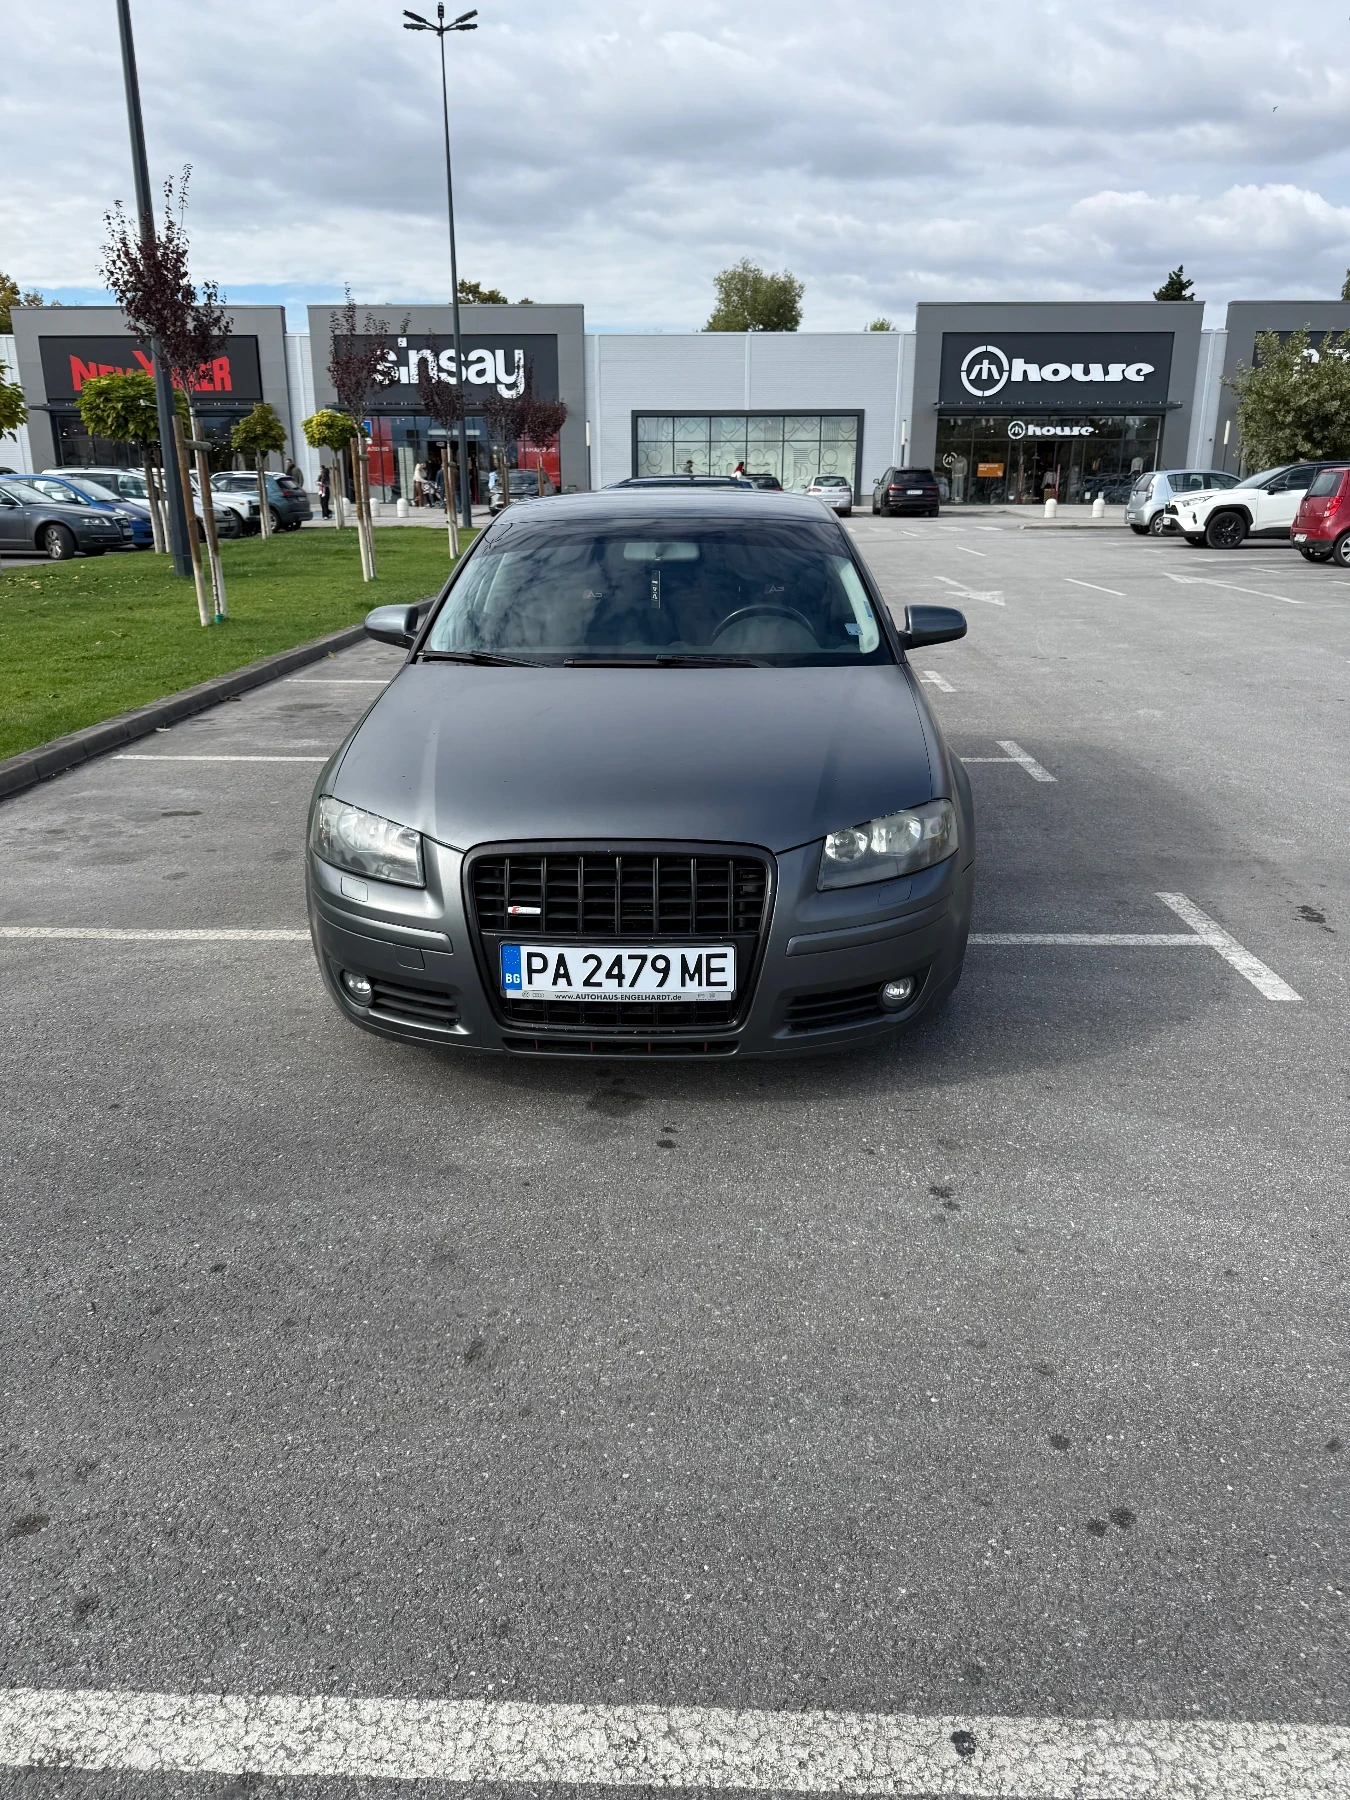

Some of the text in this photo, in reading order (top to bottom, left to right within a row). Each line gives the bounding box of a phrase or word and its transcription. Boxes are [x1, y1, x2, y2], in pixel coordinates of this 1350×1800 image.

[371, 337, 525, 399] sinsay
[1011, 358, 1155, 382] house
[1027, 424, 1095, 436] house
[505, 973, 521, 985] BG
[526, 952, 728, 988] PA 2479 ME
